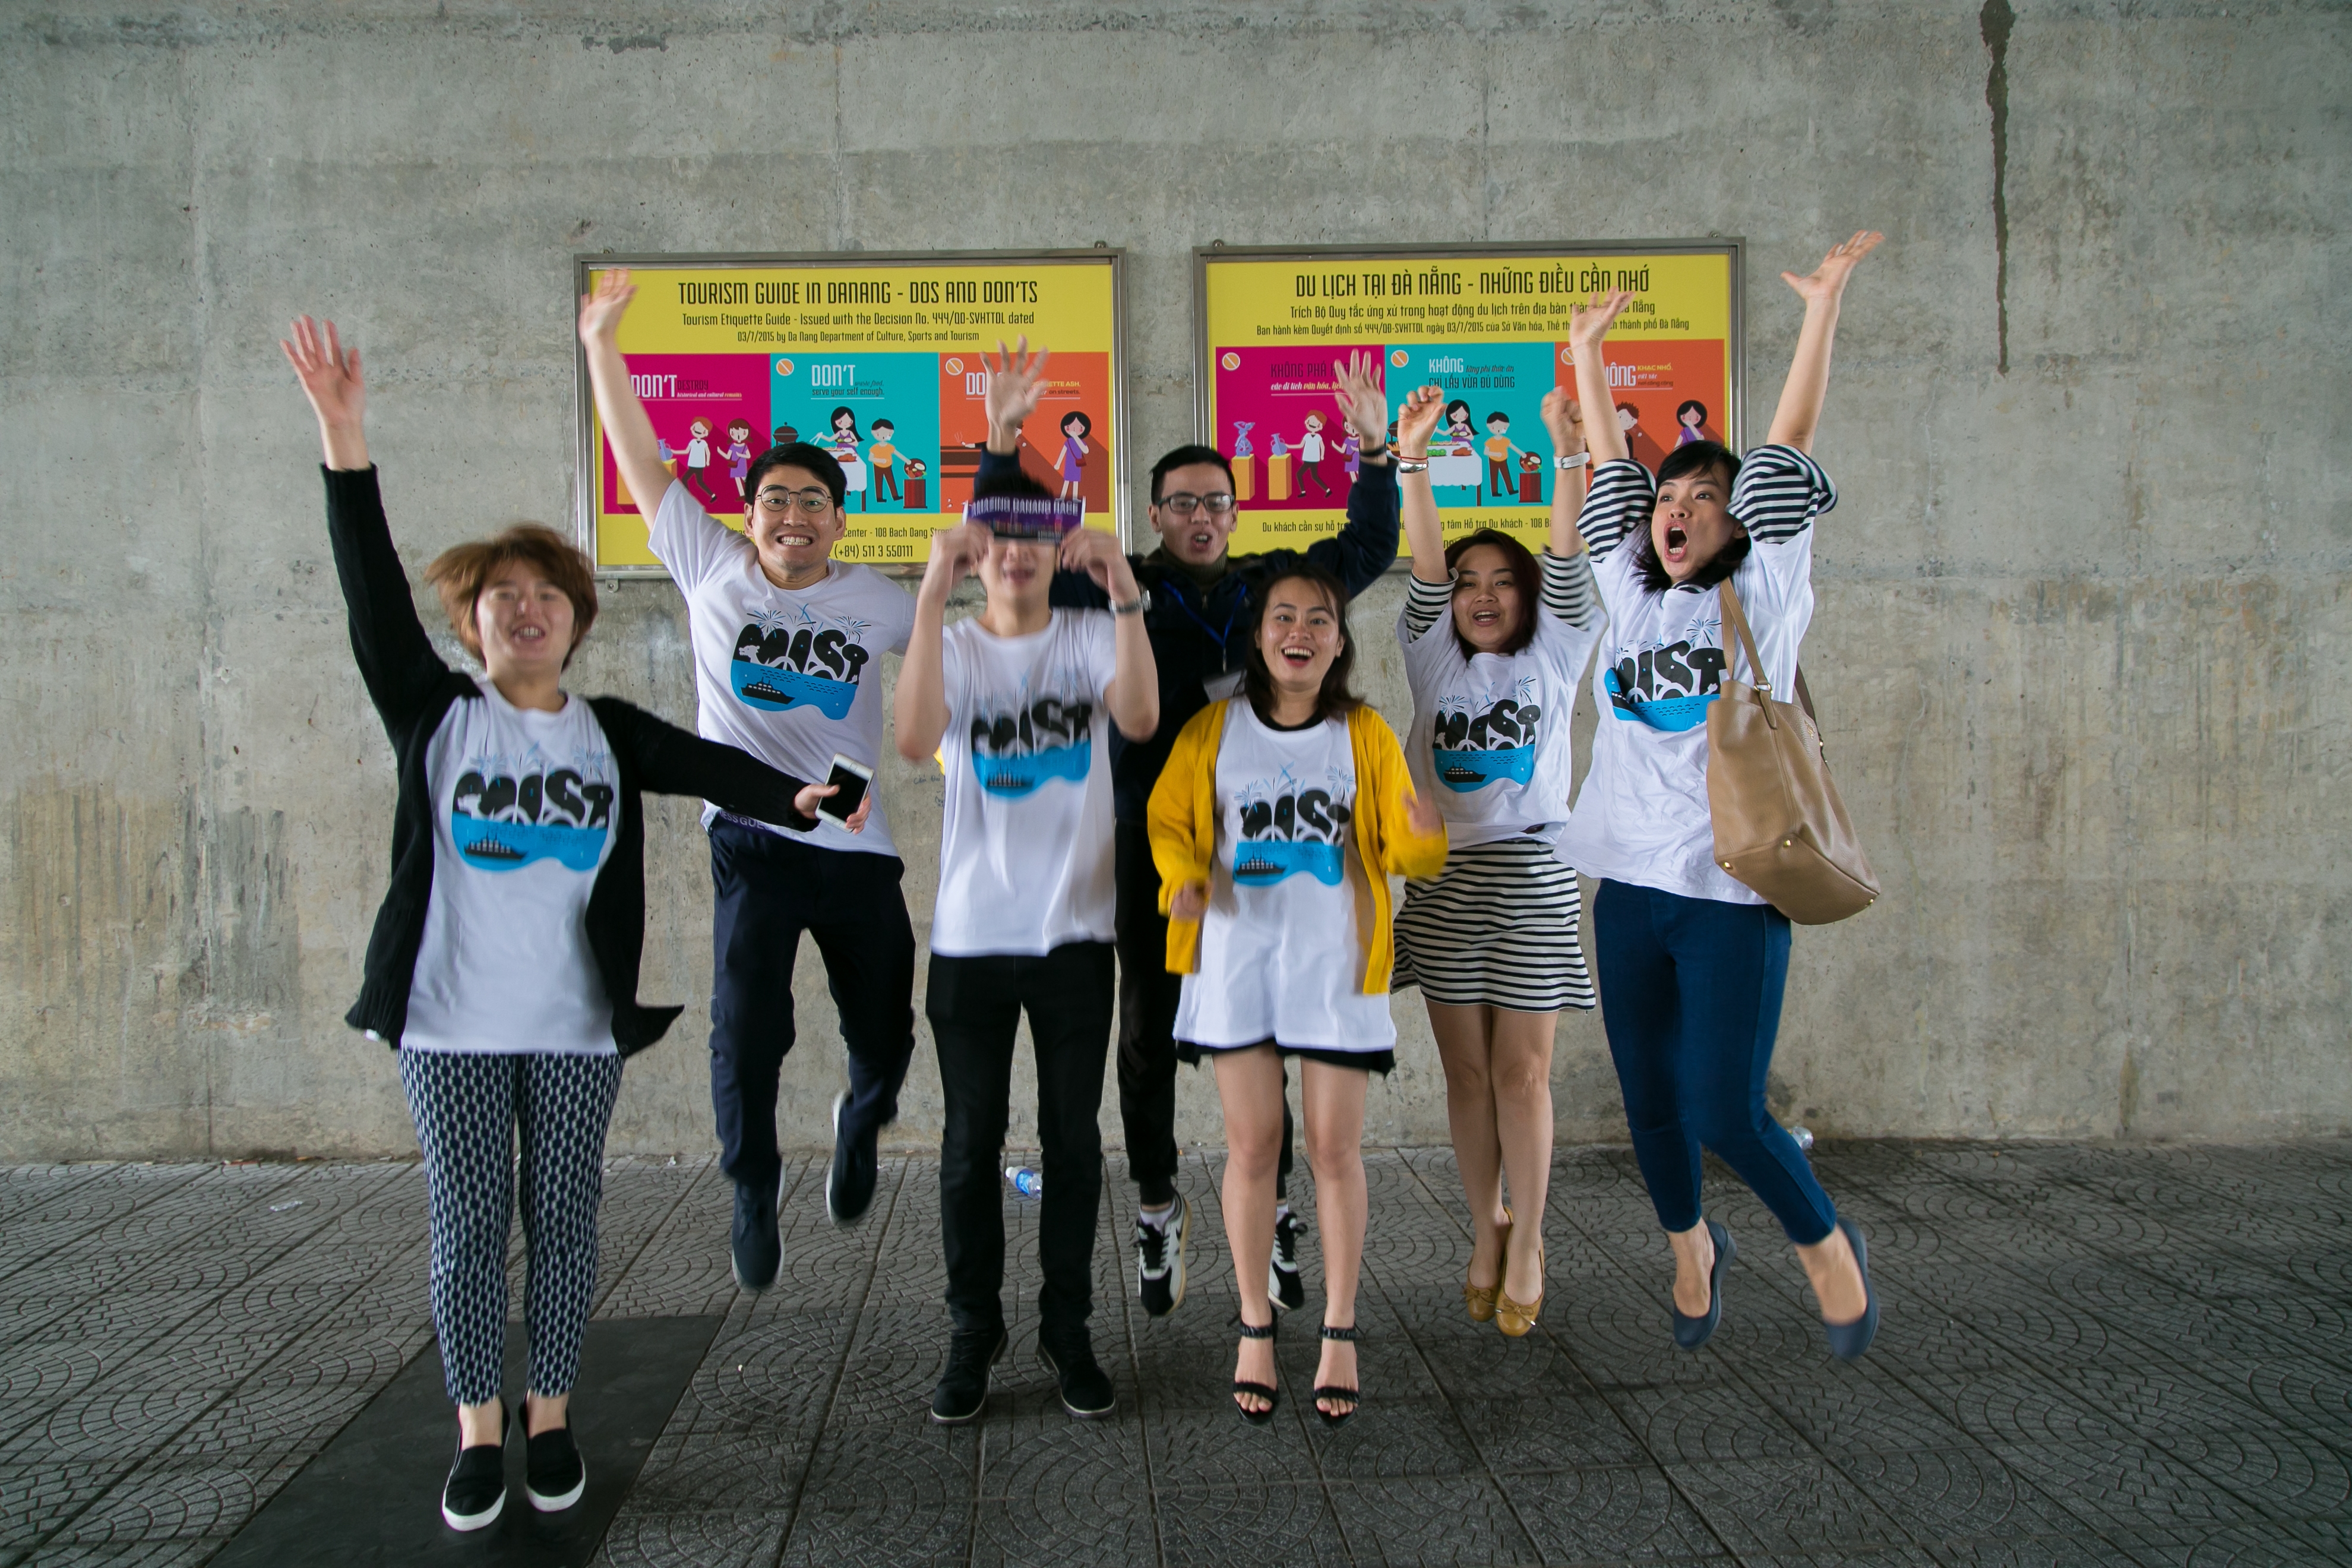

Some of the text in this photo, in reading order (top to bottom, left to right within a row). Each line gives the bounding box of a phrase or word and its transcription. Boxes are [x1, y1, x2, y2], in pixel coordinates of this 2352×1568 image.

[1297, 274, 1316, 297] DU
[1323, 274, 1355, 299] LỊCH
[1362, 274, 1385, 299] TẠI
[1392, 269, 1412, 295] ĐÀ
[1420, 265, 1461, 295] NẴNG
[1480, 266, 1533, 294] NHỮNG
[1539, 263, 1574, 293] ĐIỀU
[1581, 263, 1611, 292] CẦN
[1618, 264, 1649, 292] NHỚ
[678, 282, 748, 304] TOURISM
[755, 282, 799, 304] GUIDE
[807, 282, 821, 304] IN
[828, 282, 890, 304] DANANG
[910, 282, 939, 304] DOS
[946, 282, 976, 303] AND
[984, 281, 1037, 303] DON'TS
[1291, 305, 1311, 318] Trích
[1316, 306, 1326, 320] Bộ
[1329, 306, 1345, 320] Quy
[1349, 303, 1364, 318] tắc
[1367, 305, 1383, 320] ứng
[1400, 305, 1425, 319] trong
[1428, 304, 1449, 318] hoạt
[1452, 304, 1474, 318] động
[1477, 303, 1488, 315] du
[1492, 303, 1507, 317] lịch
[1511, 302, 1530, 315] trên
[1533, 302, 1547, 316] địa
[1550, 302, 1566, 315] bàn
[1633, 299, 1655, 315] Nẵng
[682, 313, 717, 325] Tourism
[721, 313, 762, 327] Etiquette
[766, 312, 791, 325] Guide
[801, 312, 829, 325] Issued
[833, 312, 852, 325] with
[856, 312, 871, 324] the
[874, 312, 912, 324] Decision
[916, 312, 929, 324] No.
[1009, 311, 1033, 324] dated
[1257, 325, 1270, 336] Ban
[1273, 325, 1291, 336] hành
[1294, 324, 1309, 335] kèm
[1311, 323, 1333, 336] Quyết
[1335, 324, 1351, 336] định
[1354, 322, 1362, 334] số
[1427, 323, 1444, 334] ngày
[1447, 321, 1484, 334] 03/7/2015
[1513, 320, 1526, 331] Văn
[1529, 320, 1544, 333] hóa,
[1547, 319, 1560, 331] Thể
[1620, 319, 1641, 330] thành
[1643, 317, 1657, 331] phố
[1659, 318, 1668, 329] Đà
[1671, 317, 1689, 330] Nẵng
[738, 330, 979, 343] 03/7/2015 by Da Nang Department of Culture, Sports and Tourism
[1270, 361, 1303, 377] KHÔNG
[1308, 360, 1326, 377] PHÁ
[1428, 356, 1463, 373] KHÔNG
[811, 365, 856, 386] DON'T
[1445, 373, 1459, 388] LẤY
[1462, 374, 1478, 388] VỪA
[1480, 374, 1491, 388] ĐỦ
[1494, 374, 1515, 388] DÙNG
[1605, 362, 1636, 387] ÔNG
[631, 374, 677, 397] DON'T
[677, 380, 709, 390] DESTROY
[861, 387, 884, 397] enough.
[1263, 522, 1272, 532] Du
[1274, 521, 1296, 532] khách
[1299, 520, 1312, 531] cần
[1315, 523, 1323, 532] sự
[1326, 520, 1335, 530] hỗ
[1447, 520, 1461, 529] tâm
[1464, 518, 1473, 529] Hỗ
[1489, 519, 1498, 528] Du
[1501, 518, 1523, 528] khách
[1531, 518, 1542, 528] 108
[875, 528, 887, 538] 108
[890, 527, 908, 538] Bach
[910, 527, 927, 539] Dang
[834, 543, 913, 559] (+84) 511 3 550111
